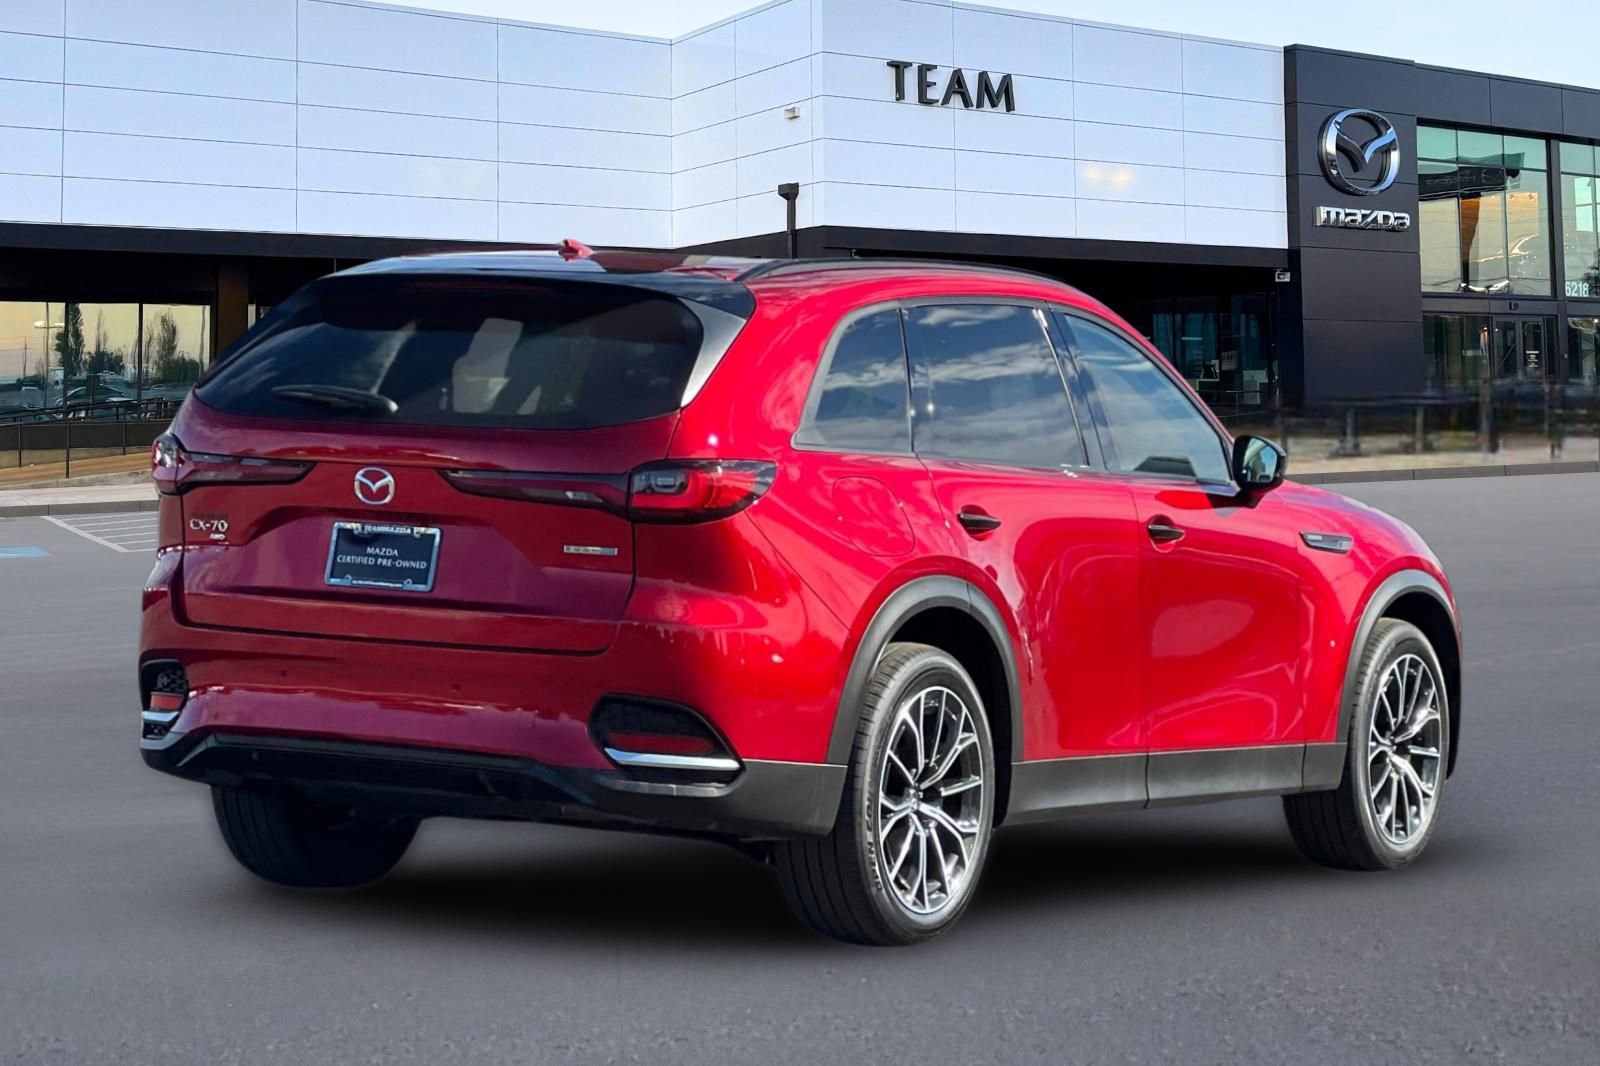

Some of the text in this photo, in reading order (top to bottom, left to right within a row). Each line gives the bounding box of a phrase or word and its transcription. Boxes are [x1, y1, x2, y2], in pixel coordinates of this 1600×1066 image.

[886, 60, 1015, 112] TEAM
[1565, 281, 1589, 297] 6218
[190, 519, 228, 532] CX-70
[366, 546, 399, 557] MAZDA
[336, 554, 427, 569] CERTIFIED PRE-OWNED
